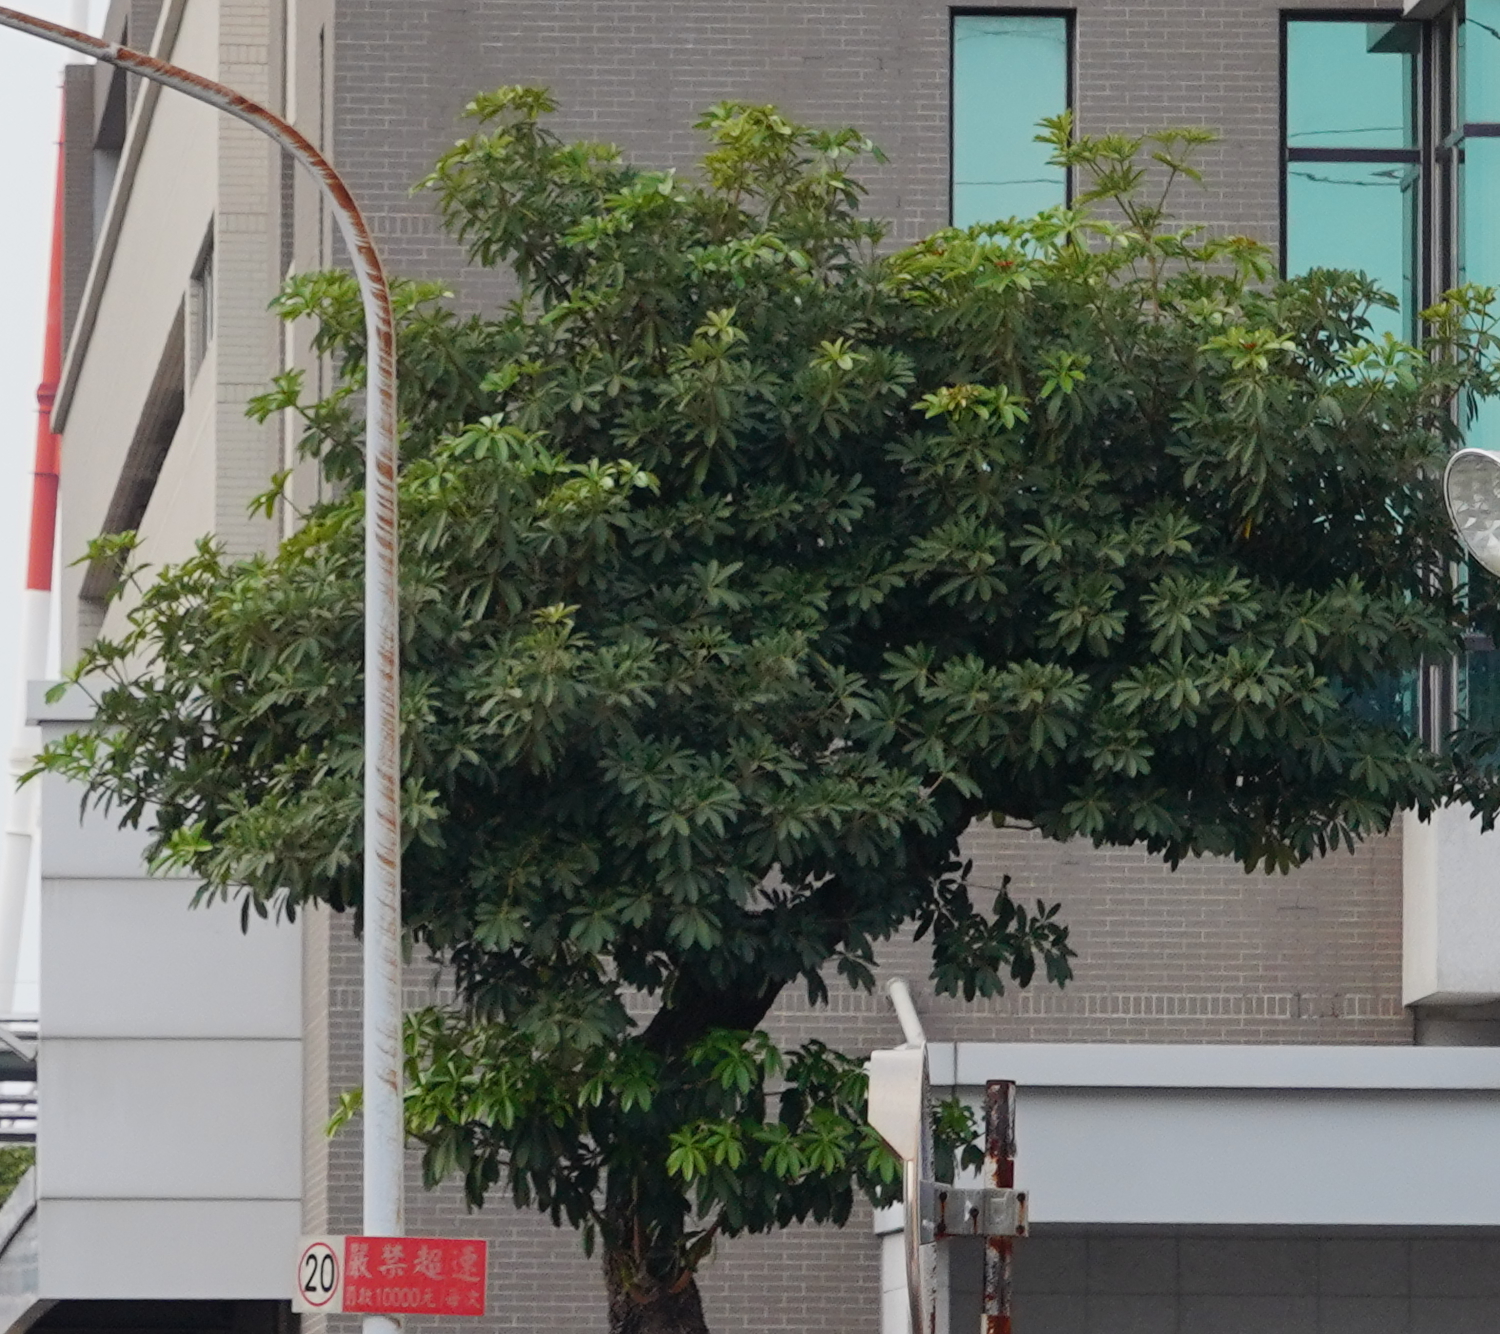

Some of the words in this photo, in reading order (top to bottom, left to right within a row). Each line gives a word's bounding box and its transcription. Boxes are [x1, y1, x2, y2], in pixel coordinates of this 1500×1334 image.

[304, 1253, 335, 1293] 20
[347, 1242, 482, 1283] 嚴禁超速
